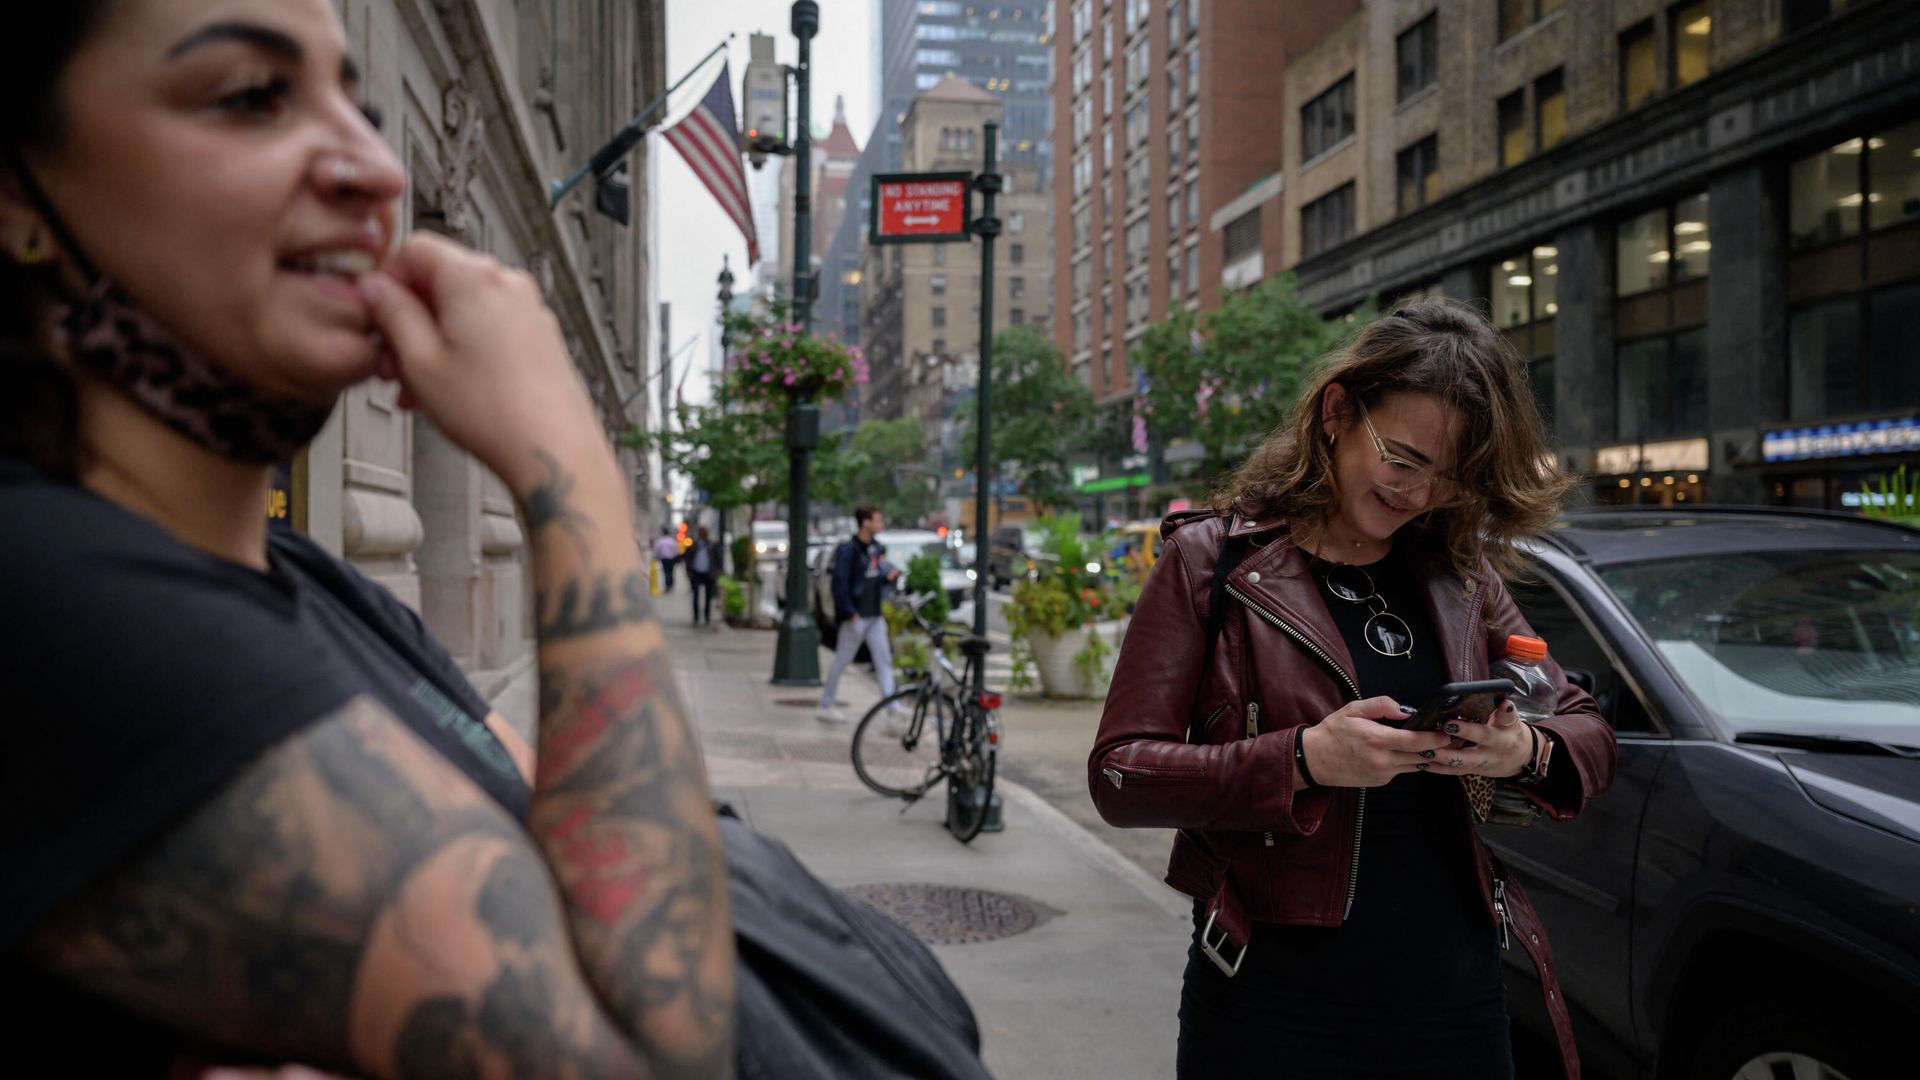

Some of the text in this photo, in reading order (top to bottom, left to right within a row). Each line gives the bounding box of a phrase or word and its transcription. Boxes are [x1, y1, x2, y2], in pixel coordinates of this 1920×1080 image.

[885, 181, 960, 197] NO STANDING
[894, 199, 950, 212] ANYTIME
